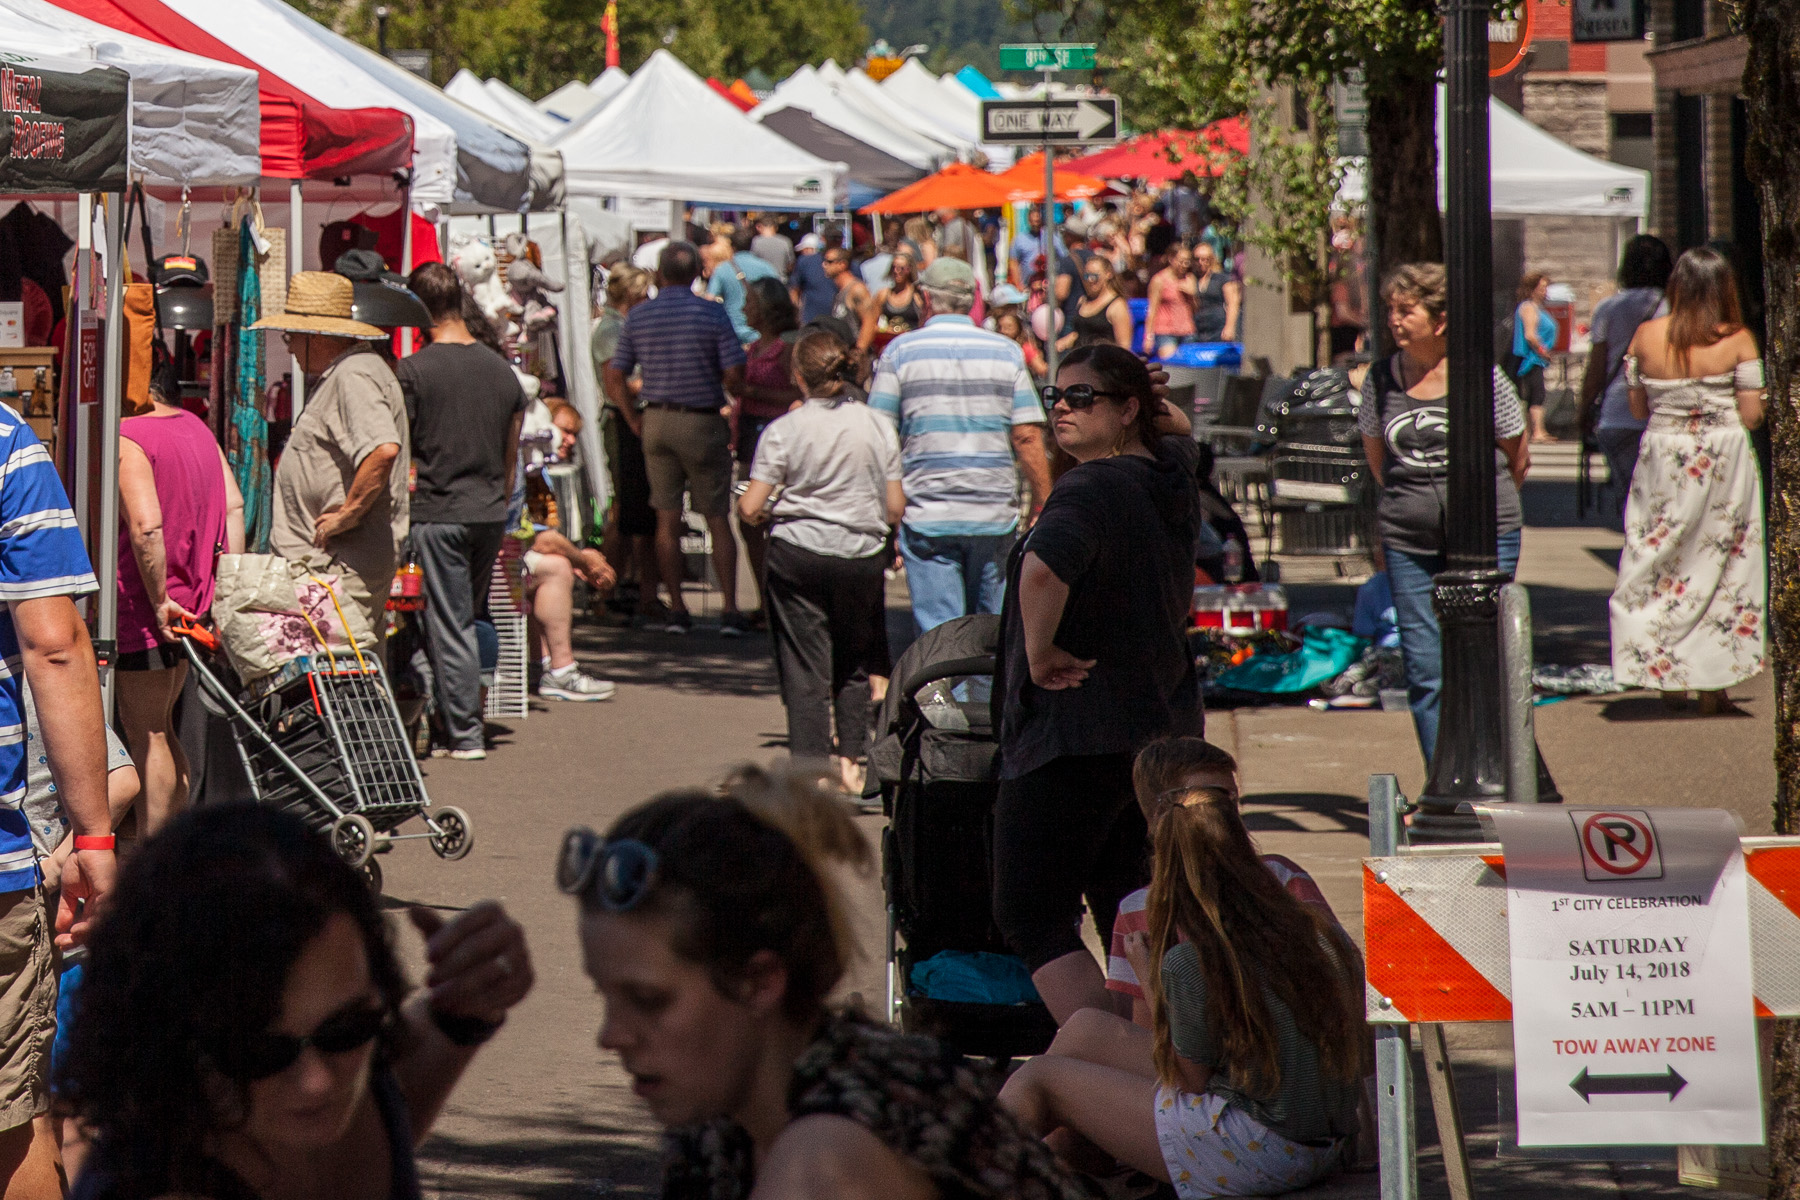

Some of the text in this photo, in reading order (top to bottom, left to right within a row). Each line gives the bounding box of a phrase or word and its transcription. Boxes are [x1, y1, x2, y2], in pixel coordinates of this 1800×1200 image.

[1, 68, 41, 113] METAL
[993, 113, 1074, 130] ONE WAY
[10, 115, 64, 159] ROOFING
[1574, 898, 1602, 912] CITY
[1607, 895, 1702, 910] CELEBRATION
[1568, 936, 1689, 956] SATURDAY
[1569, 961, 1690, 984] July 14, 2018
[1571, 1001, 1618, 1018] 5AM
[1642, 999, 1695, 1016] 11PM
[1553, 1036, 1716, 1055] TOW AWAY ZONE
